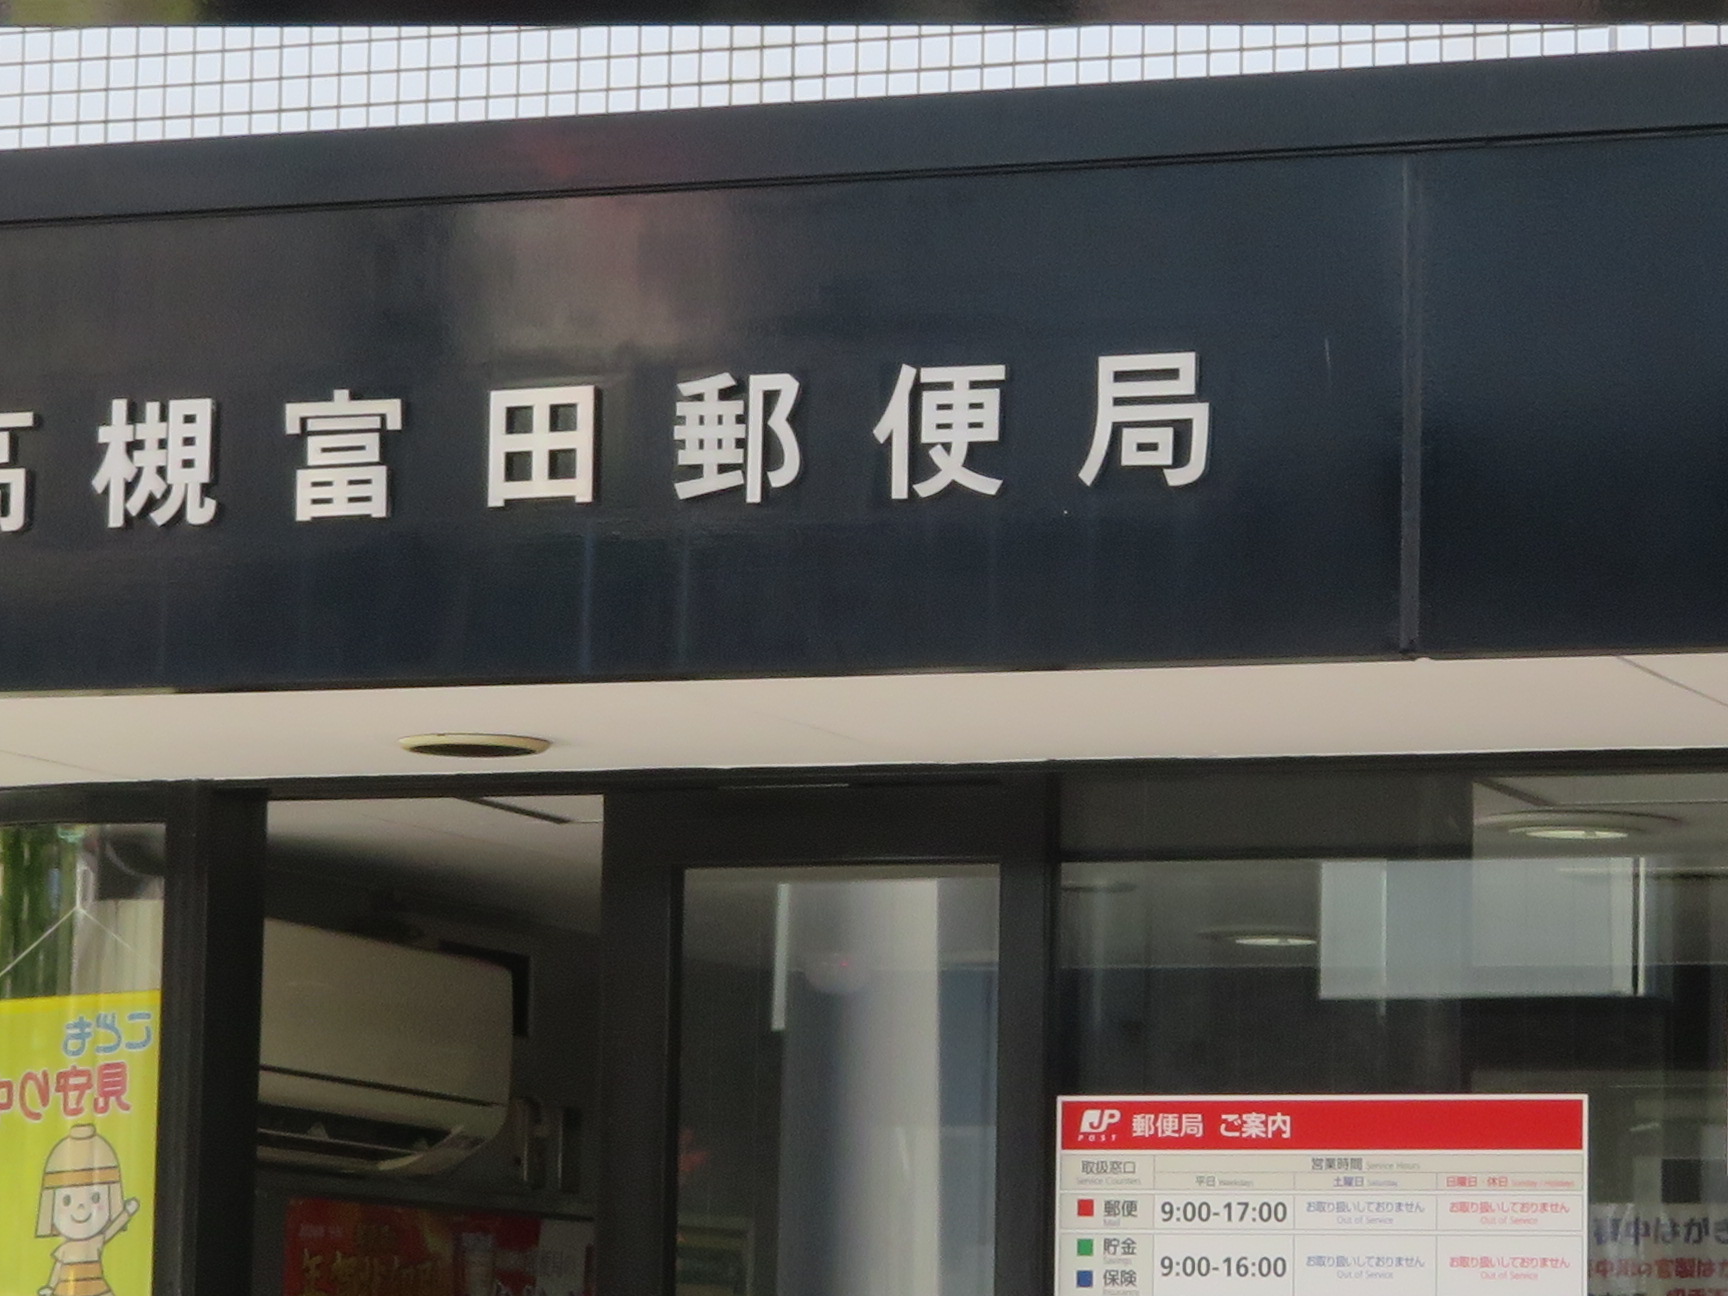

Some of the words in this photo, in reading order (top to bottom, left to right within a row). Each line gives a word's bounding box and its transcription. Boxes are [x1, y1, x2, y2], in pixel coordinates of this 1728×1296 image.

[1132, 1113, 1204, 1138] 郵便局
[1219, 1112, 1291, 1139] ご案内
[1077, 1134, 1117, 1142] POST
[1081, 1160, 1137, 1175] 取扱窓口
[1310, 1157, 1364, 1171] 営業時間
[1076, 1176, 1104, 1185] Service
[1195, 1175, 1216, 1187] 平日
[1333, 1176, 1365, 1188] 土曜日
[1102, 1199, 1139, 1219] 郵便
[1159, 1202, 1288, 1223] 9:00-17:00
[1305, 1200, 1426, 1214] お取り扱いしておりません
[1448, 1201, 1571, 1214] お取り扱いしておりません
[1336, 1215, 1352, 1225] Out
[1353, 1215, 1363, 1225] of
[1364, 1215, 1394, 1225] Service
[1480, 1215, 1497, 1225] Out
[1499, 1215, 1509, 1225] of
[1510, 1216, 1539, 1226] Service
[1102, 1237, 1137, 1256] 貯金
[1159, 1256, 1287, 1278] 9:00-16:00
[1305, 1255, 1426, 1268] お取り扱いしておりません
[1448, 1256, 1571, 1269] お取り扱いしておりません
[1102, 1269, 1138, 1287] 保険
[1336, 1270, 1352, 1280] Out
[1353, 1270, 1363, 1280] of
[1364, 1270, 1394, 1280] Service
[1480, 1270, 1497, 1280] Out
[1499, 1270, 1509, 1280] of
[1510, 1271, 1539, 1281] Service
